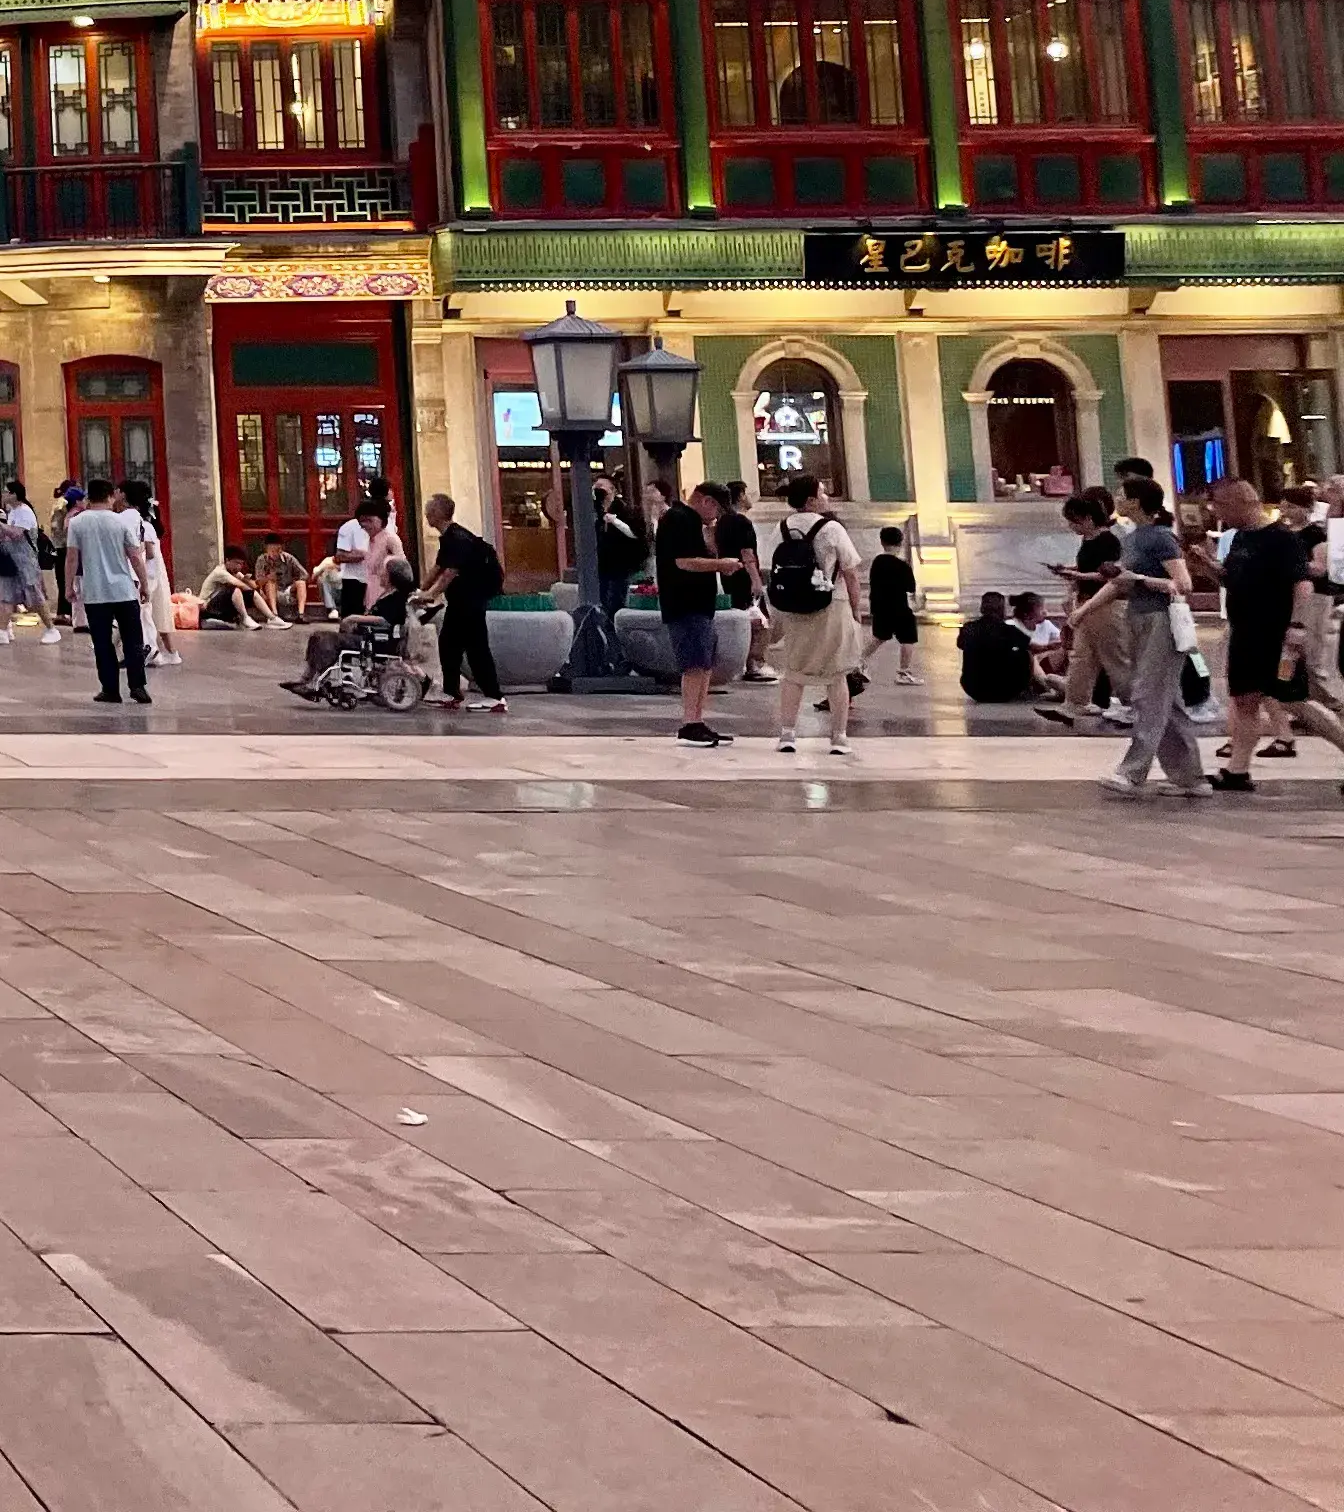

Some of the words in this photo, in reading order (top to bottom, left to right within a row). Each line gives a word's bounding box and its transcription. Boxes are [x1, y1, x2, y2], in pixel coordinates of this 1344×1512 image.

[859, 238, 1072, 273] 星巴克咖啡
[779, 444, 804, 471] R
